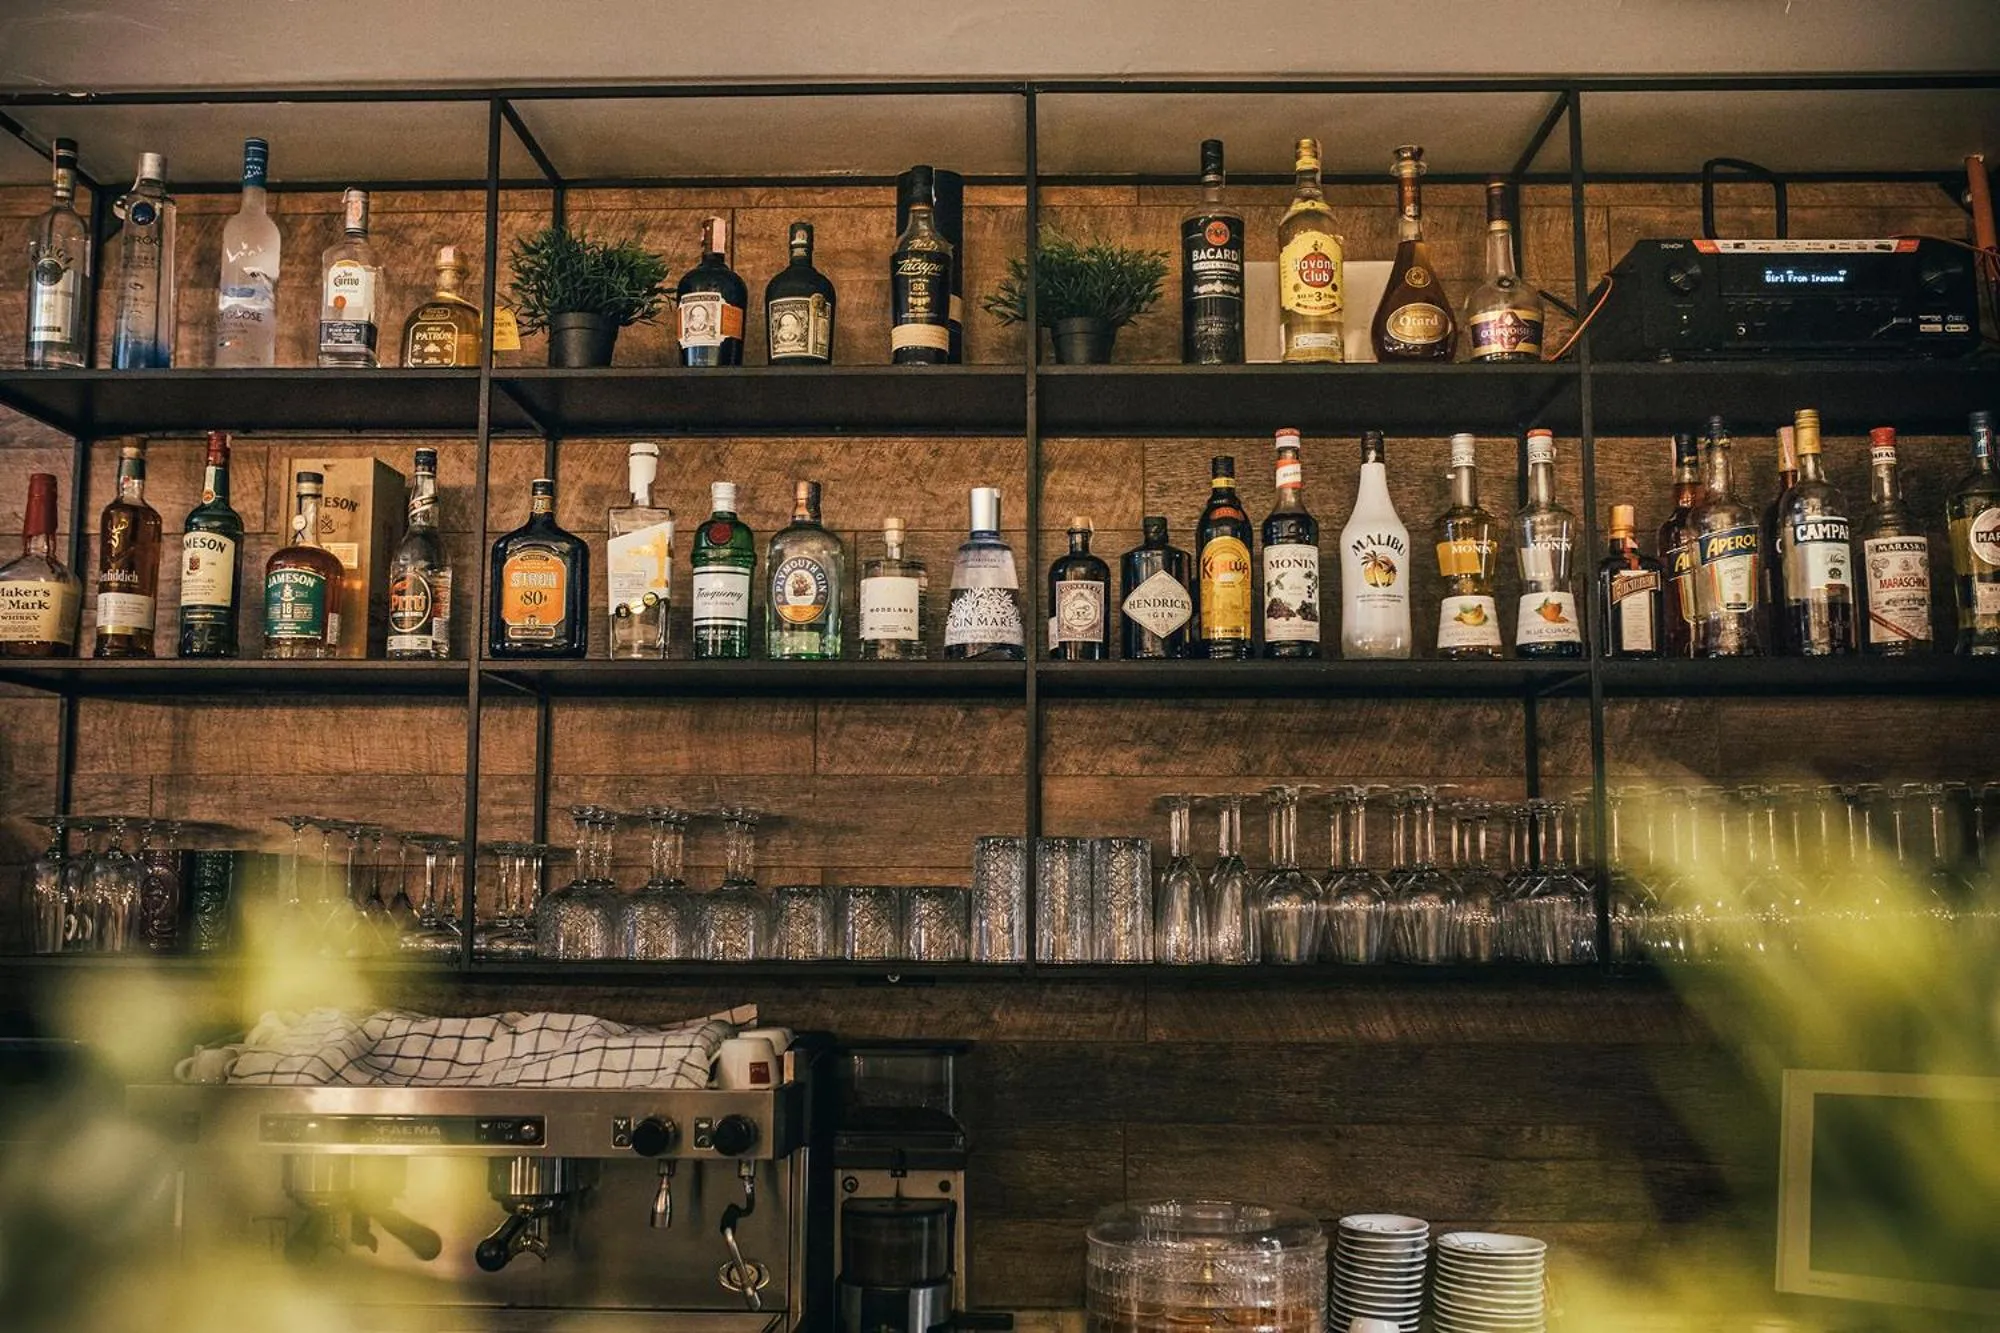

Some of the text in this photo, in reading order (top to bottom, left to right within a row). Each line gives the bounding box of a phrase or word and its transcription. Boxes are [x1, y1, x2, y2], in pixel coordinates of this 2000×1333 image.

[1294, 258, 1337, 271] Havana
[1303, 270, 1329, 282] Club
[1765, 274, 1784, 282] Girl
[324, 497, 358, 512] ESON
[1352, 533, 1406, 557] MALIBU
[1268, 559, 1317, 571] MONIN
[268, 572, 314, 588] JAMESON
[775, 558, 828, 593] PLYMOUTH GIN
[523, 590, 543, 606] 80
[8, 599, 51, 610] Mark
[282, 602, 292, 614] 18
[952, 616, 1014, 628] GIN MARE
